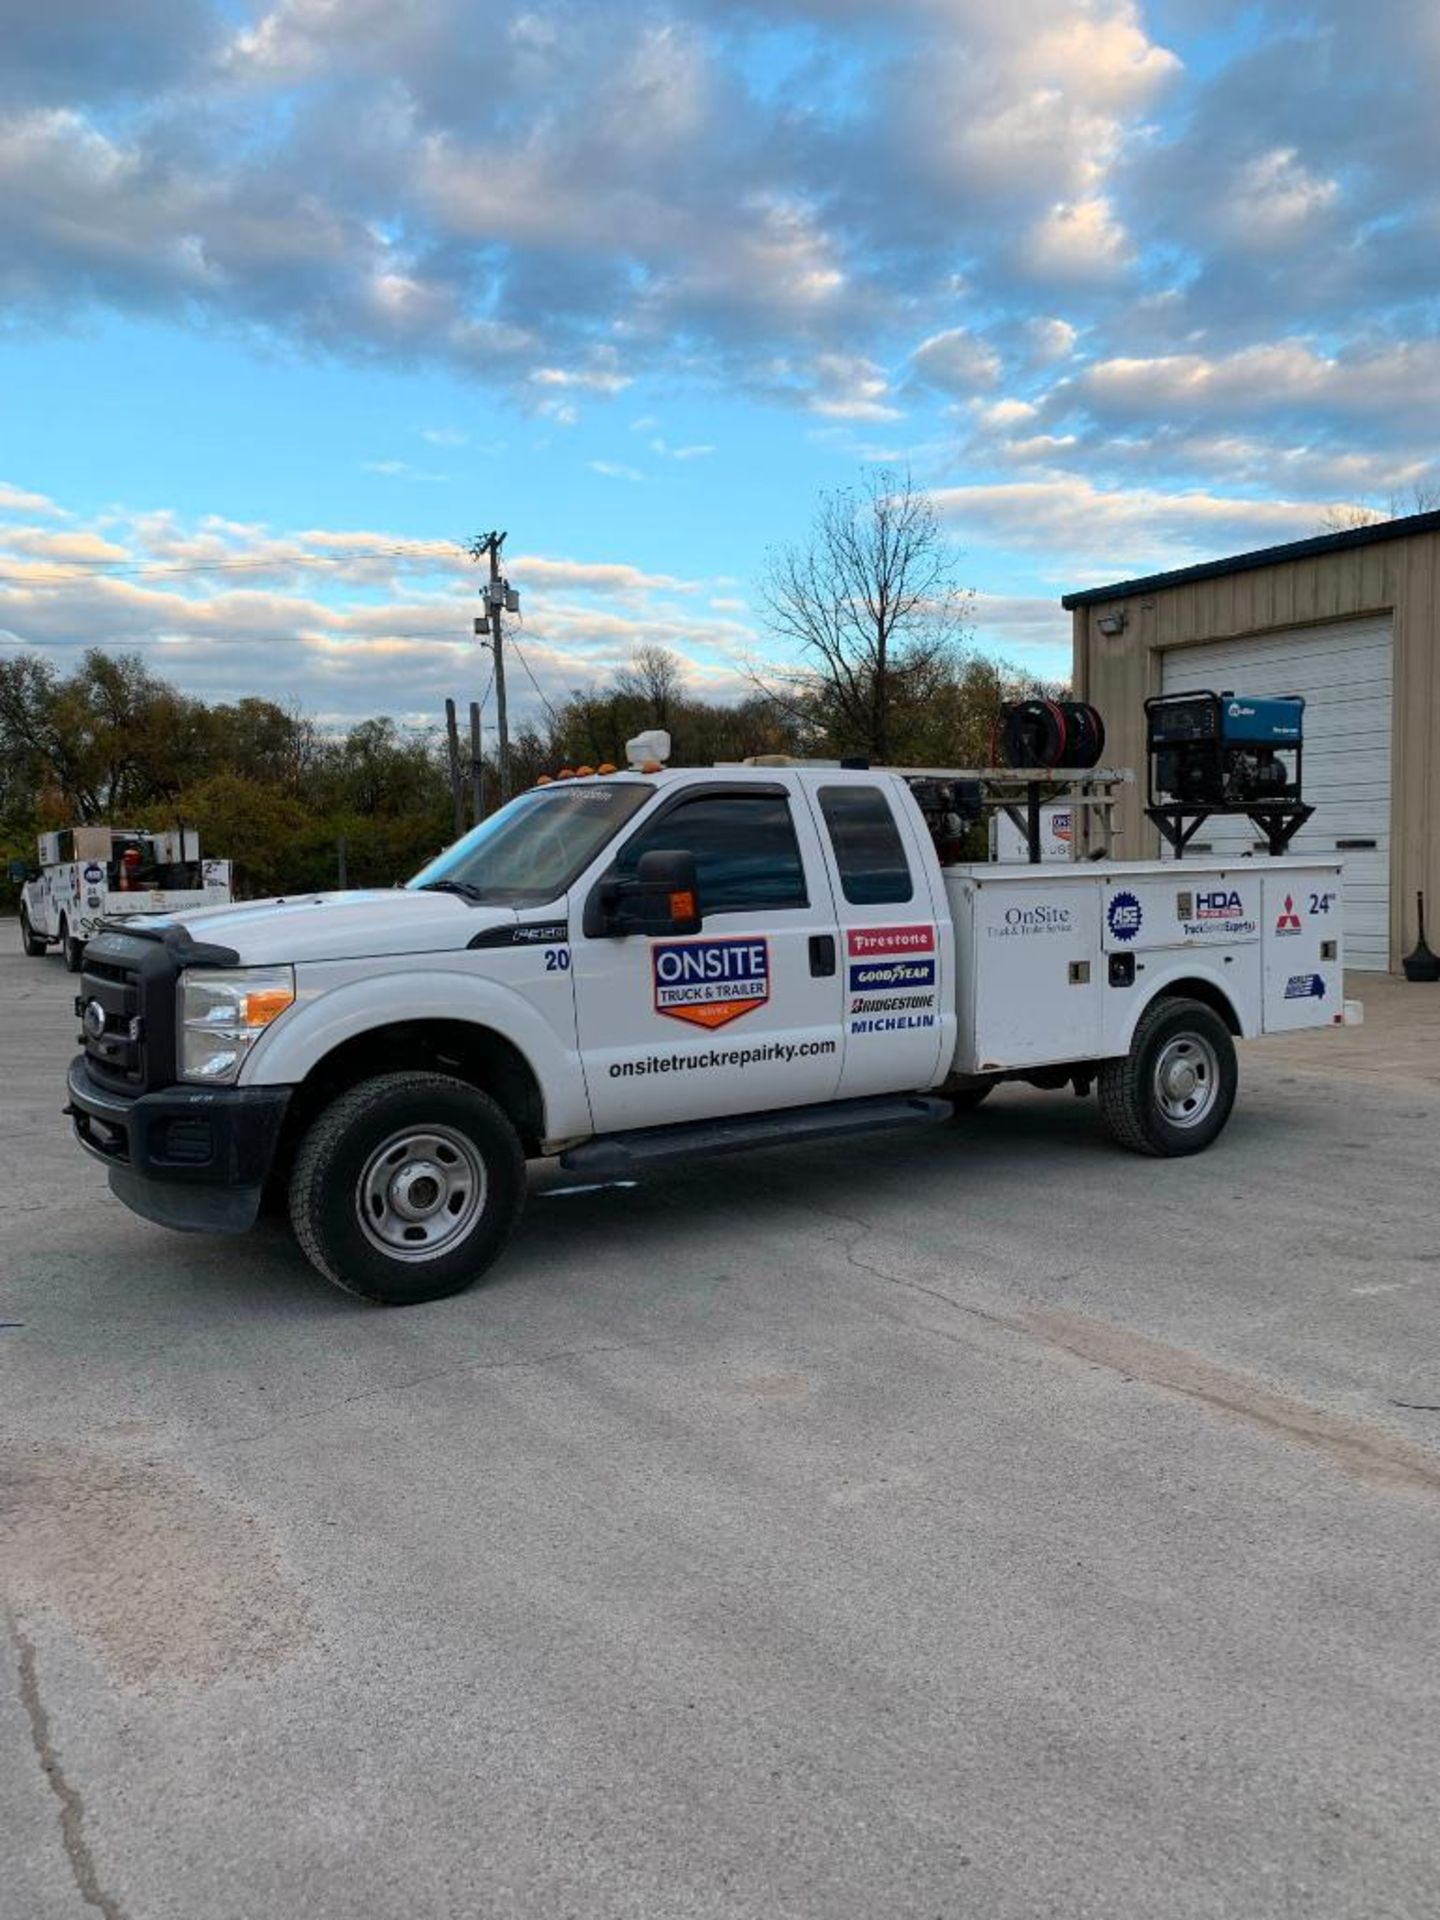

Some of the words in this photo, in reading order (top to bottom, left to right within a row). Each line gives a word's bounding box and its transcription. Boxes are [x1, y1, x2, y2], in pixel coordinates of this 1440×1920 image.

[1196, 891, 1242, 909] HDA
[1005, 906, 1070, 925] OnSite
[1111, 906, 1138, 925] ASE
[854, 934, 928, 950] Firestone
[544, 949, 570, 971] 20
[656, 945, 765, 981] ONSITE
[858, 965, 930, 983] GOODYEAR
[660, 987, 703, 1003] TRUCK
[705, 986, 714, 999] &
[716, 982, 764, 998] TRAILER
[851, 994, 935, 1014] BRIDGESTONE
[851, 1015, 934, 1034] MICHELIN
[609, 1039, 836, 1078] onsitetruckrepairky.com
